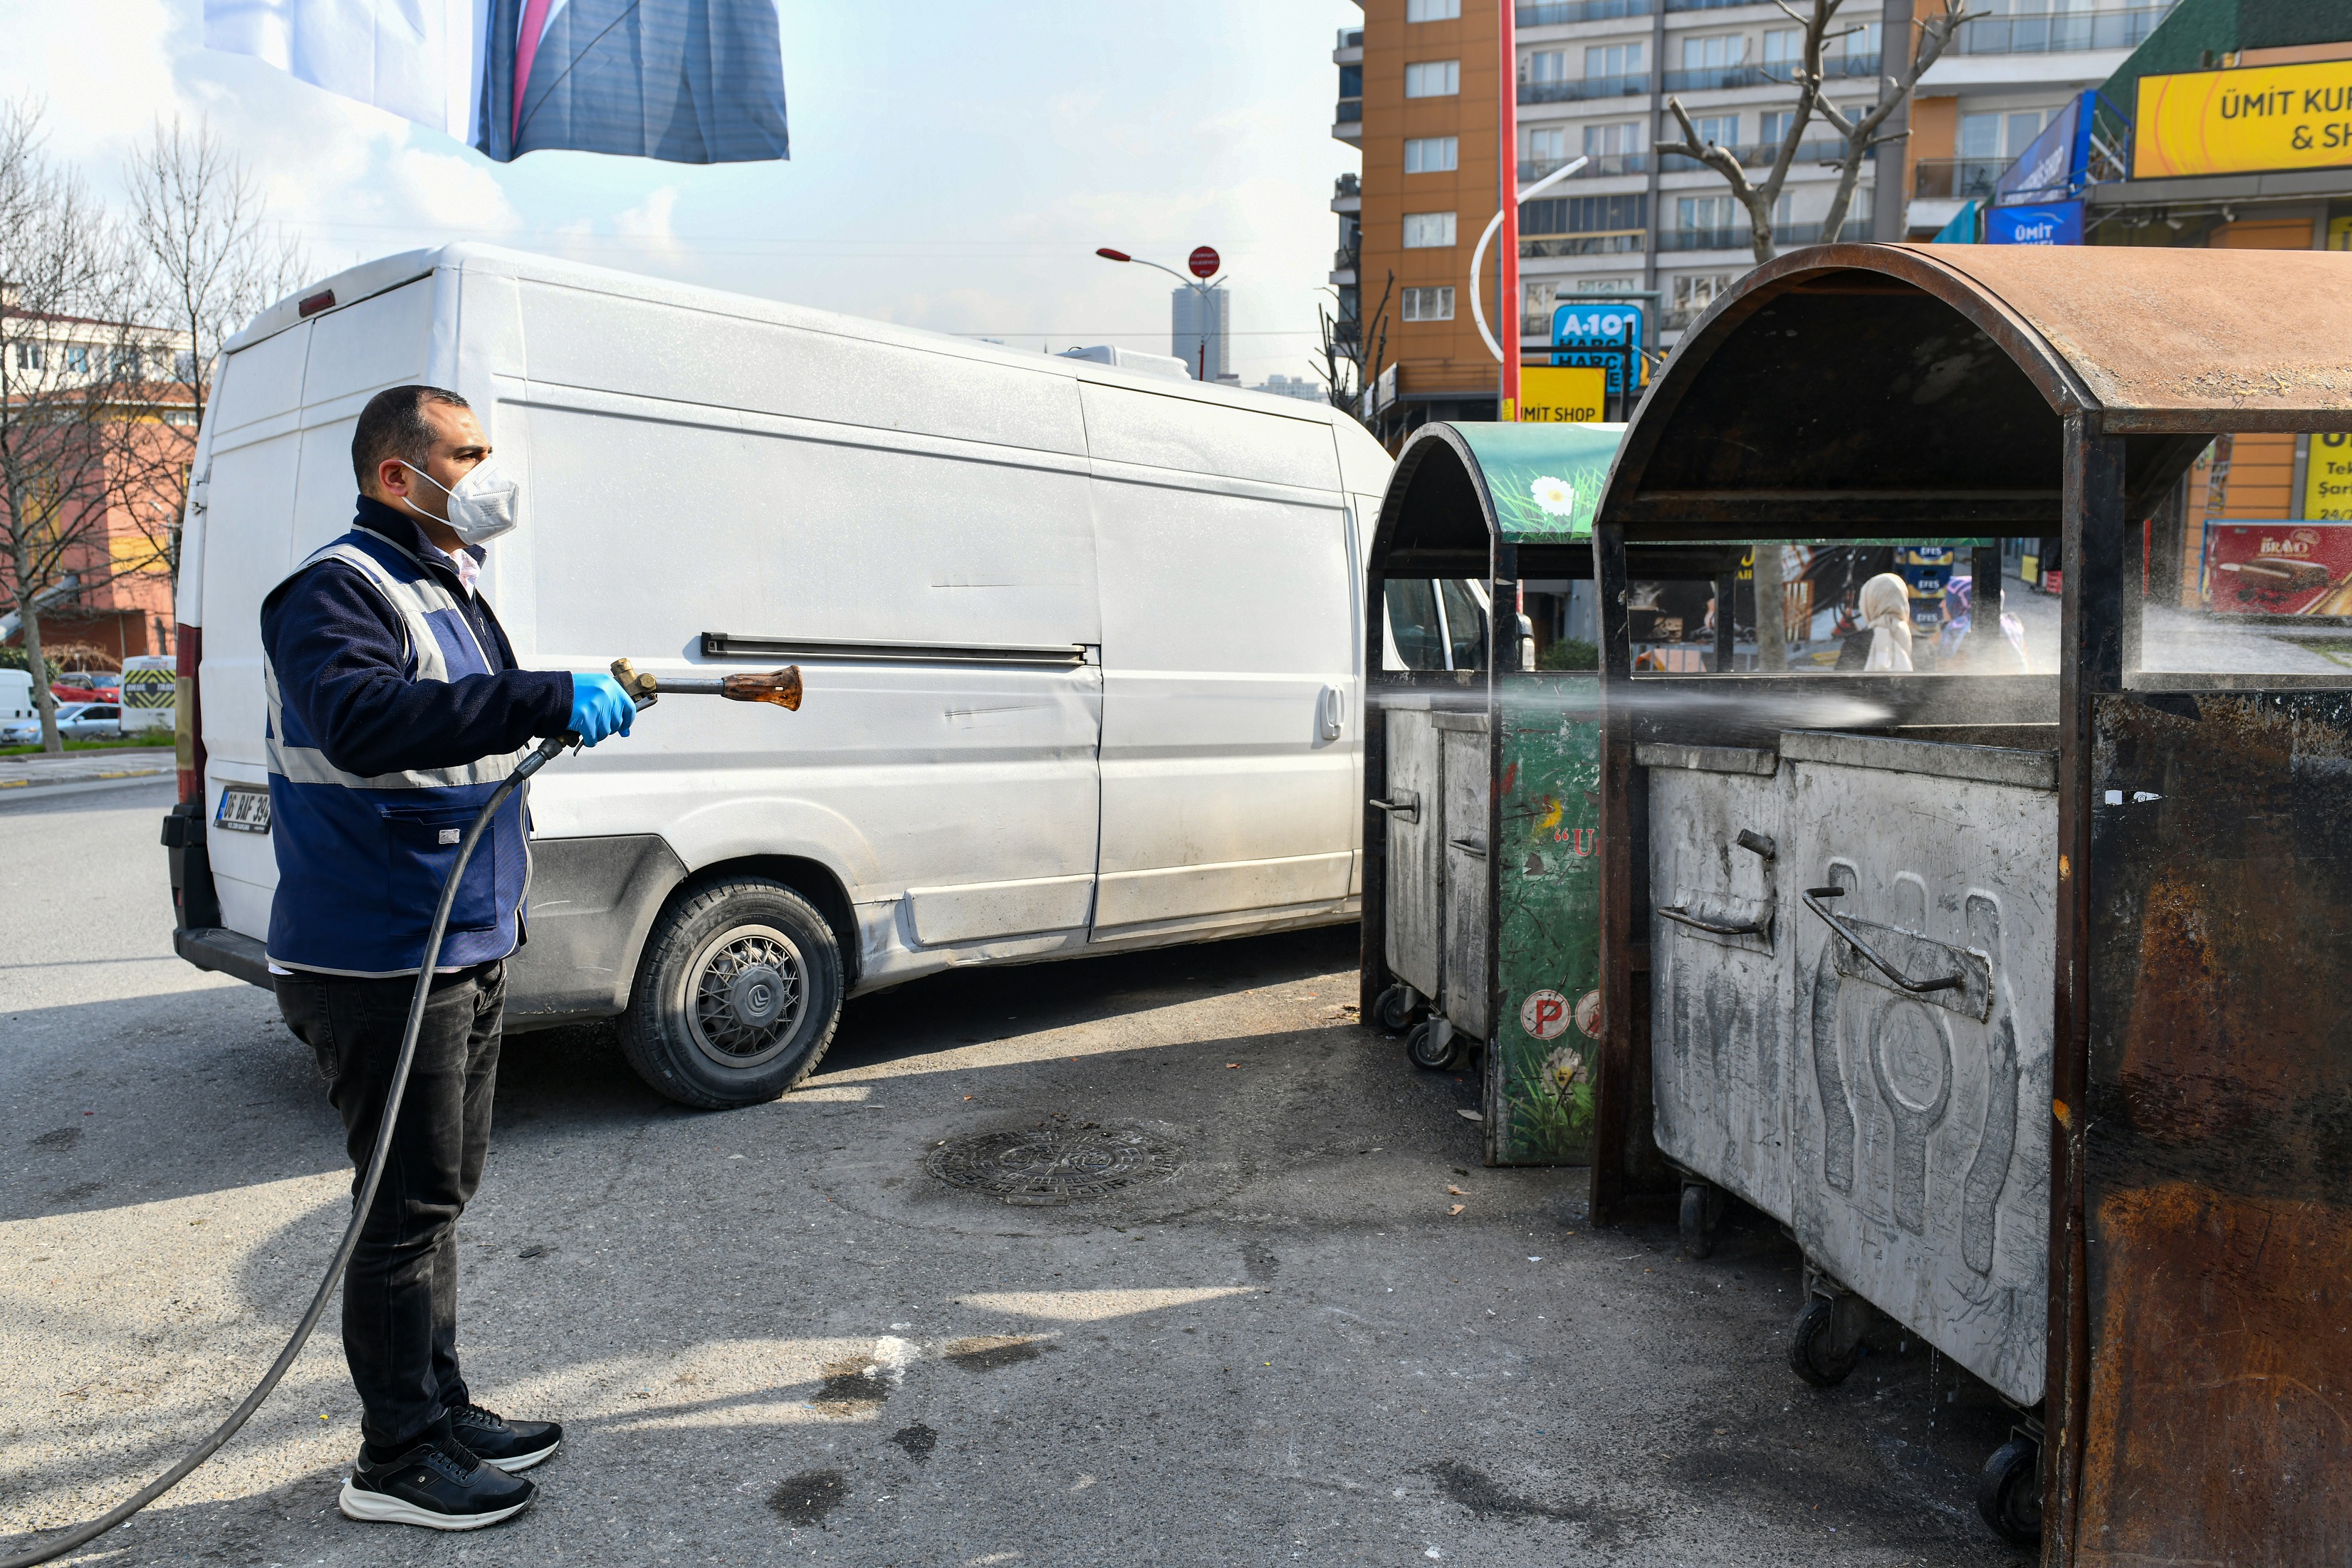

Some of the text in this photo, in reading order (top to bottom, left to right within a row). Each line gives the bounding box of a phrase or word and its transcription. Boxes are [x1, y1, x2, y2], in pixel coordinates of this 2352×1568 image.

[2221, 85, 2352, 119] ÜMİT KU
[2291, 125, 2314, 150] &
[2014, 222, 2054, 242] ÜMİT
[1520, 403, 1550, 422] MİT
[1554, 407, 1595, 422] SHOP
[1920, 546, 1943, 555] EFES
[1918, 580, 1940, 589] EFES
[1916, 613, 1938, 622] EFES
[224, 793, 237, 819] 06
[236, 794, 256, 821] BAF
